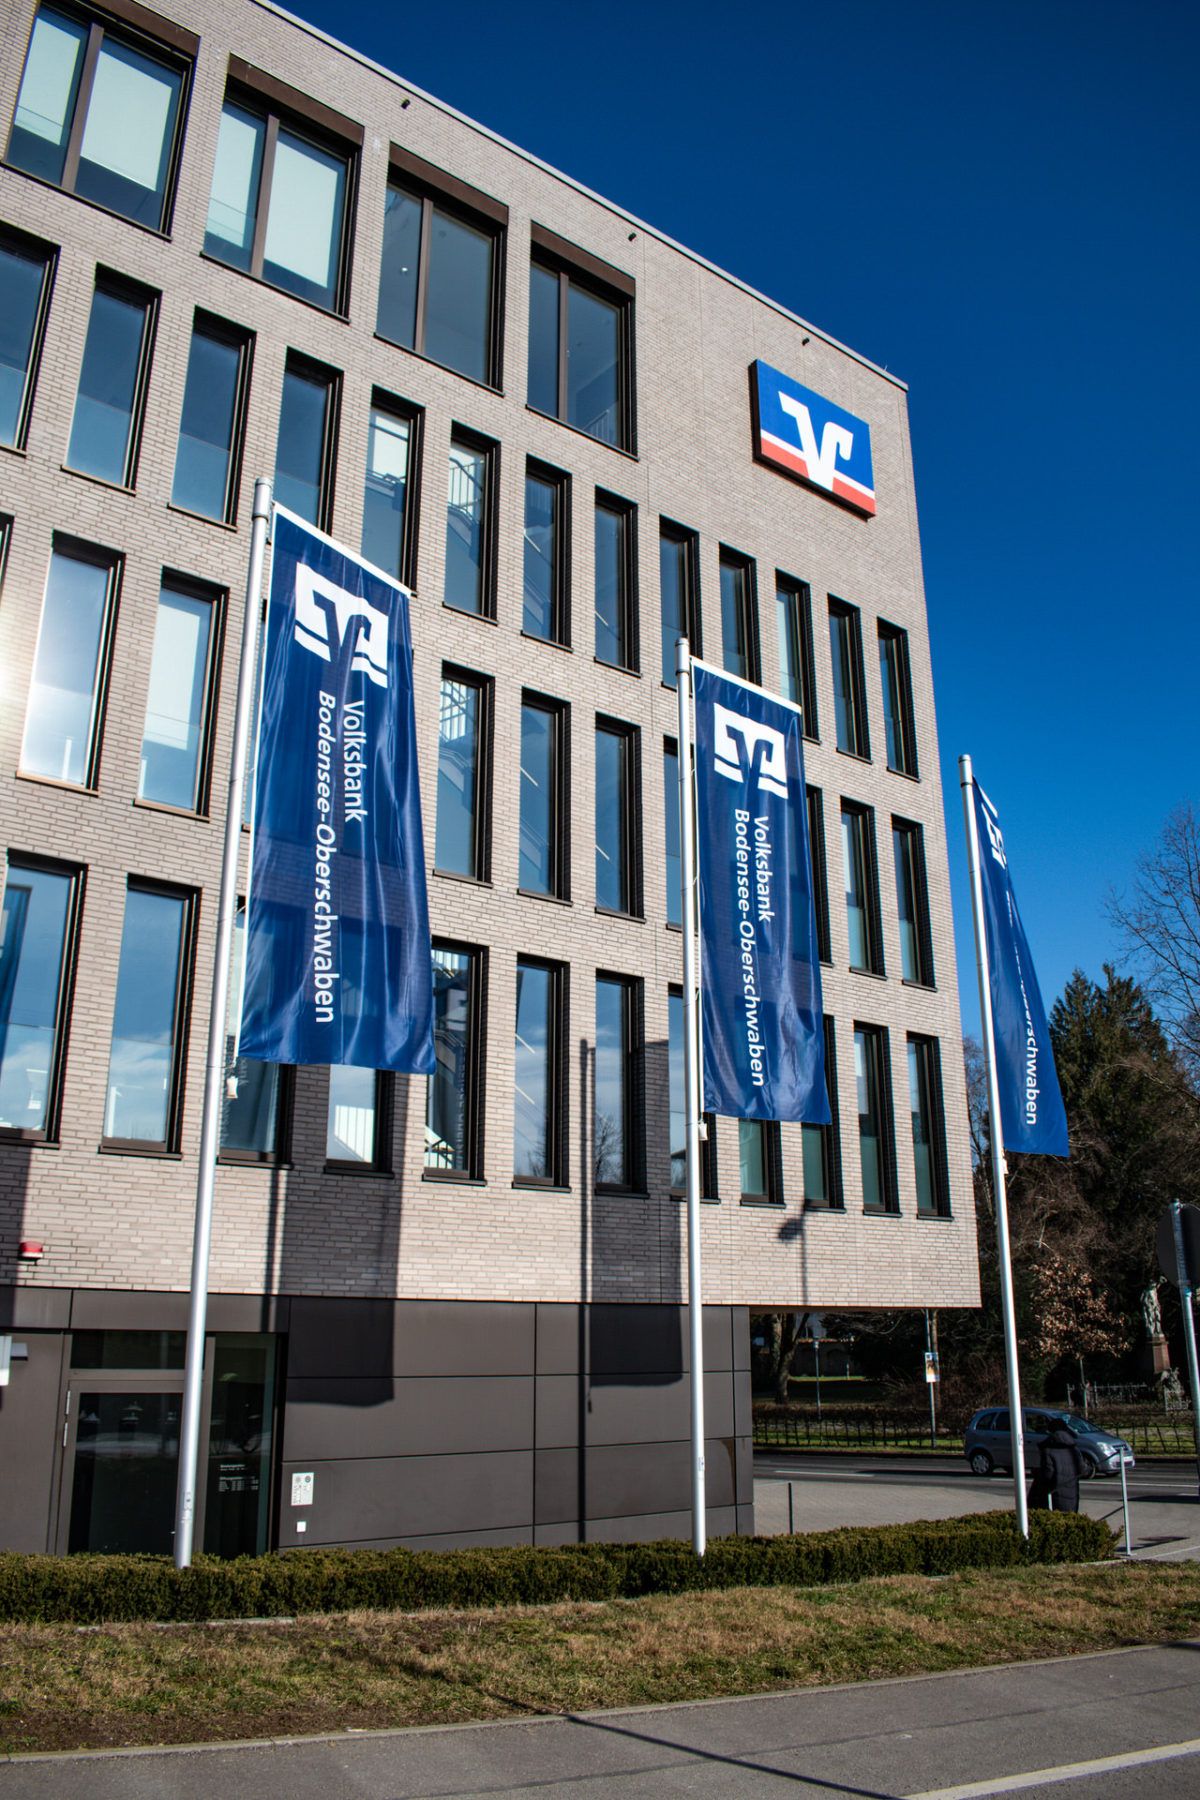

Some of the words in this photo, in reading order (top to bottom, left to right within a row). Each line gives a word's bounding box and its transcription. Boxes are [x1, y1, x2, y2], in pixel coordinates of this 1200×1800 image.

[314, 690, 340, 1023] Bodensee-Oberschwaben
[343, 700, 368, 822] Volksbank
[734, 808, 765, 1087] Bodensee-Oberschwaben
[754, 815, 774, 923] Volksbank
